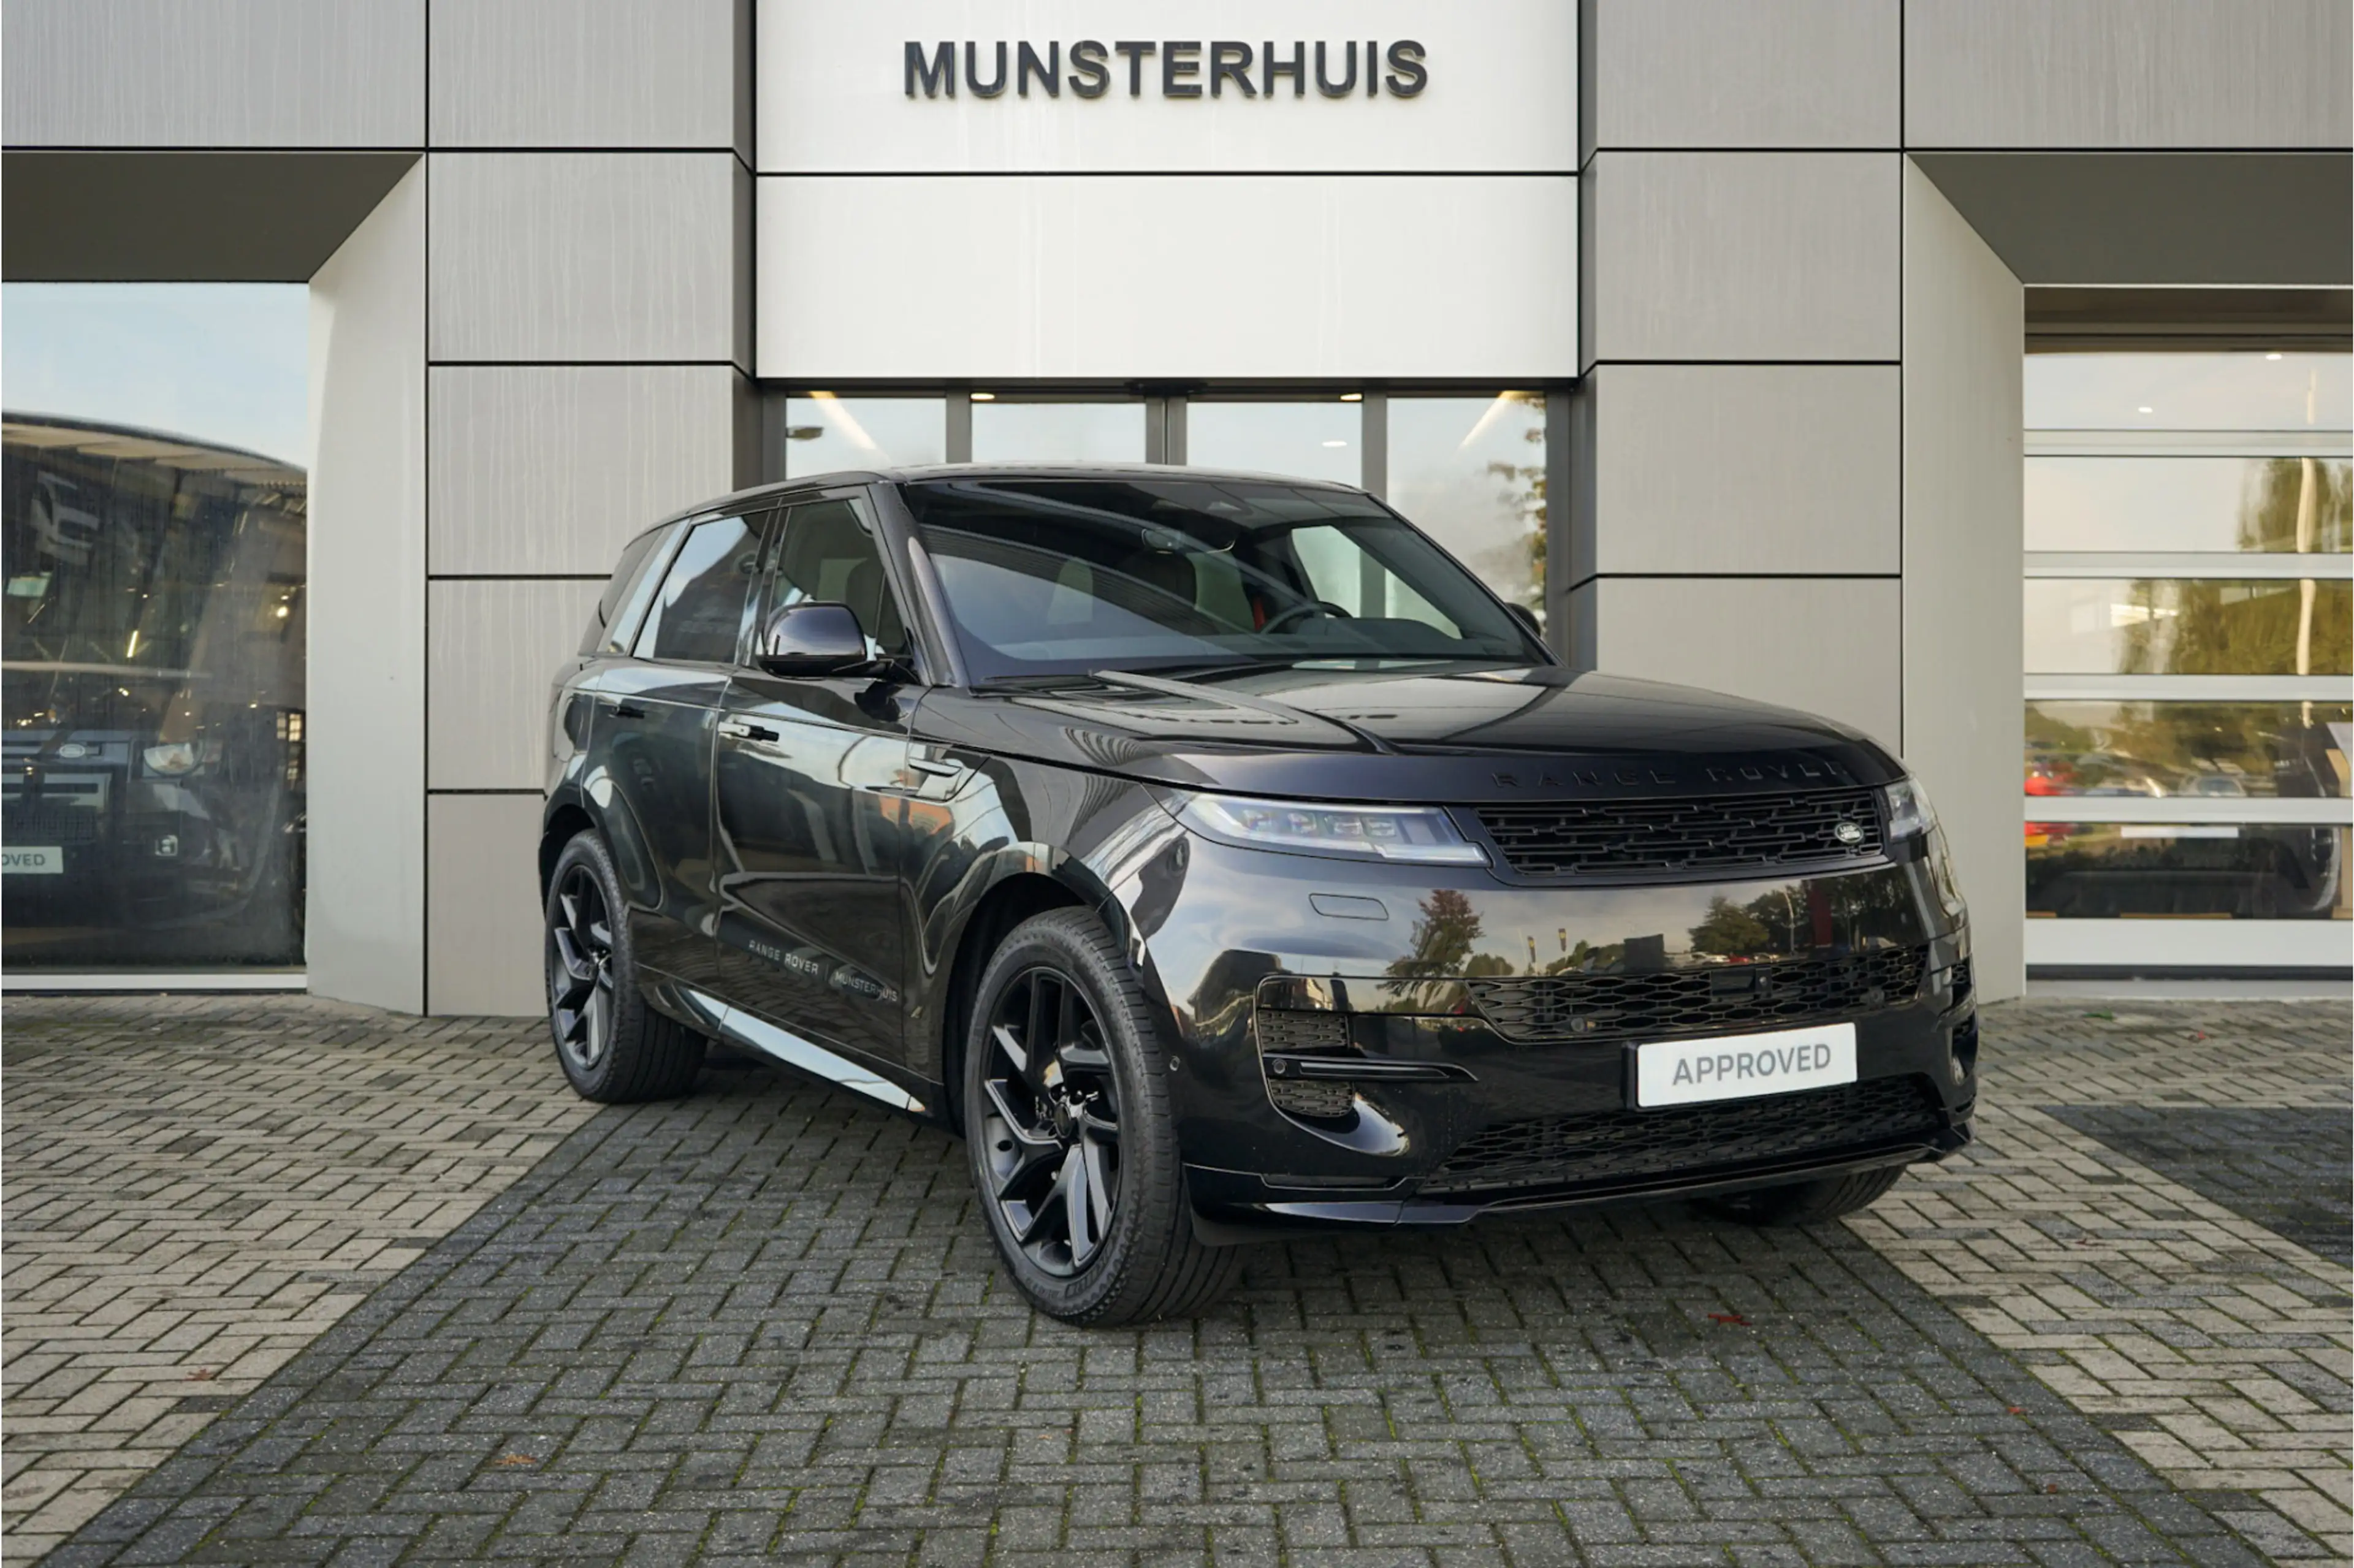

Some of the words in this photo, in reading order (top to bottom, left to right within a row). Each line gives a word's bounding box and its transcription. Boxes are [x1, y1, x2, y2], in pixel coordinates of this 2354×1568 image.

[904, 40, 1429, 99] MUNSTERHUIS
[1491, 769, 1677, 788] RANGE
[748, 939, 780, 961] RANGE
[785, 952, 819, 975] ROVER
[1672, 1043, 1832, 1086] APPROVED
